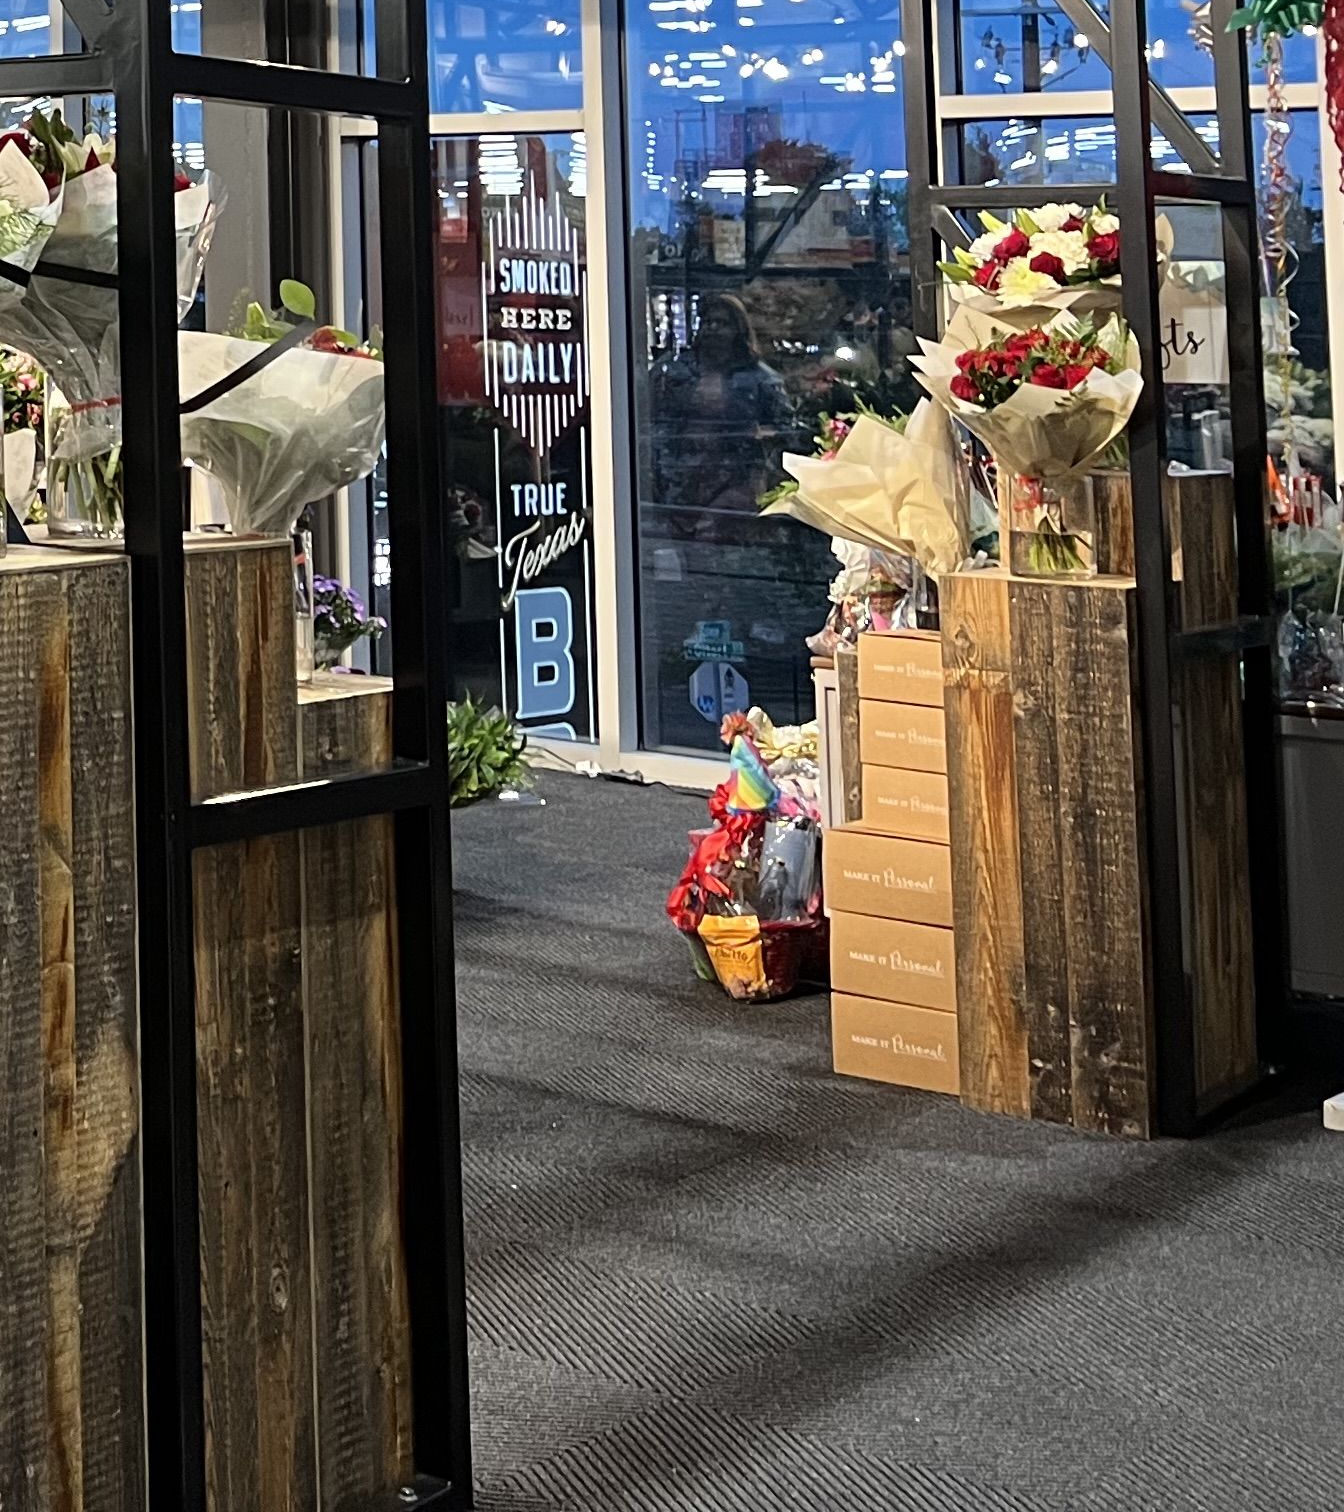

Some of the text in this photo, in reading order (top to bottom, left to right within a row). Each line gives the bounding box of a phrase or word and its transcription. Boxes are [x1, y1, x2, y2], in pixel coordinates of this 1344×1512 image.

[499, 257, 573, 296] SMOKED
[500, 306, 572, 331] HERE
[503, 340, 573, 384] DAILY
[511, 482, 567, 517] TRUE
[500, 511, 586, 611] Texas
[843, 867, 936, 891] MAKE IT Personal
[849, 949, 944, 975] MAKE IT Personal
[851, 1034, 946, 1060] MAKE IT Personal
